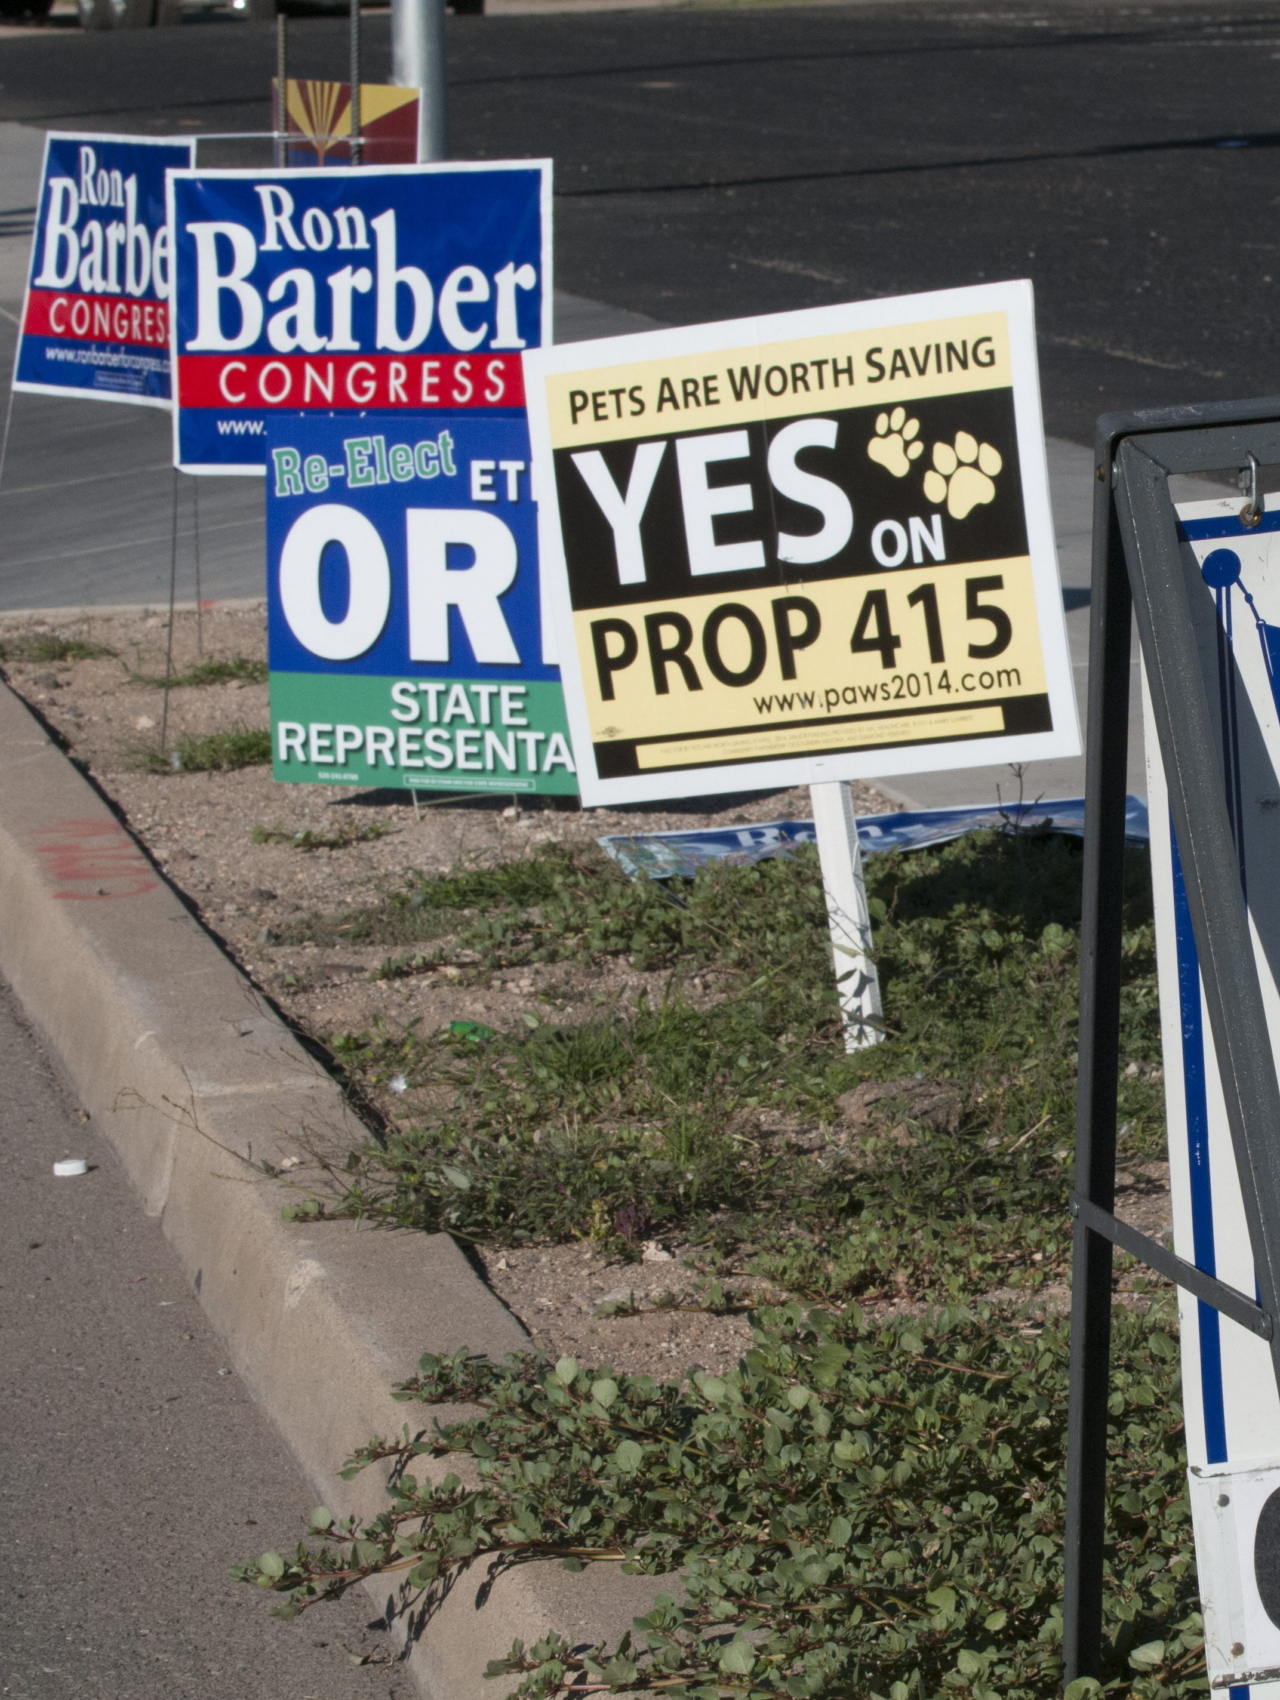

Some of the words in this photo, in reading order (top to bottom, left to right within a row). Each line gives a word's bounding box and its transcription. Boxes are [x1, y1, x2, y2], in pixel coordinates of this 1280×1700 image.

[78, 146, 125, 207] Ron
[34, 173, 169, 300] Barbe
[255, 184, 370, 252] Ron
[186, 209, 536, 353] Barber
[50, 297, 166, 342] CONGRES
[219, 360, 505, 403] CONGRESS
[569, 384, 646, 425] PETS
[656, 374, 721, 414] ARE
[727, 357, 855, 401] WORTH
[865, 336, 996, 384] SAVING
[271, 430, 457, 497] Re-Elect
[471, 459, 538, 502] ET
[570, 418, 854, 586] YES
[871, 514, 946, 568] ON
[590, 595, 822, 702] PROP
[849, 574, 1013, 671] 415
[391, 682, 528, 726] STATE
[753, 666, 1022, 714] www.paws2014.com
[277, 721, 577, 774] REPRESENTA
